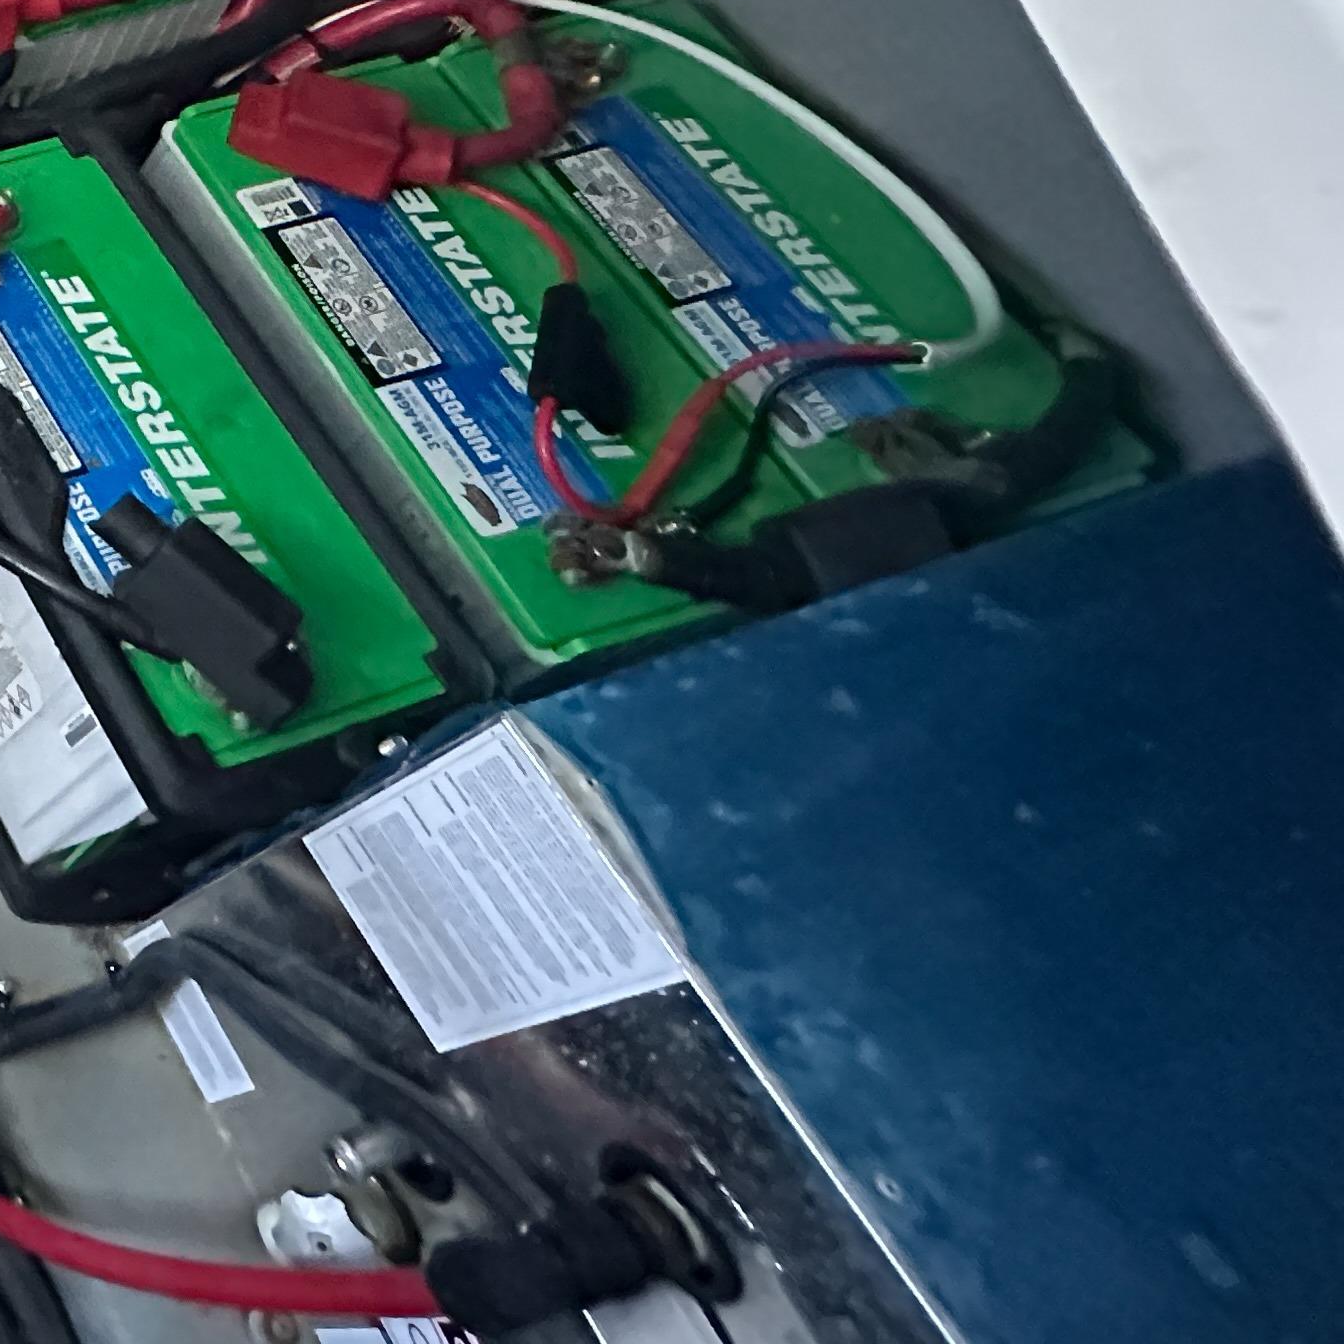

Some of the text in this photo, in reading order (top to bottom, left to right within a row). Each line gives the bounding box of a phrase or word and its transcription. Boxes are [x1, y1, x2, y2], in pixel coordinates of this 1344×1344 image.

[291, 262, 356, 346] DANGER/POISON
[388, 387, 440, 452] 31M-AGM
[423, 375, 542, 517] DUAL PURPOSE
